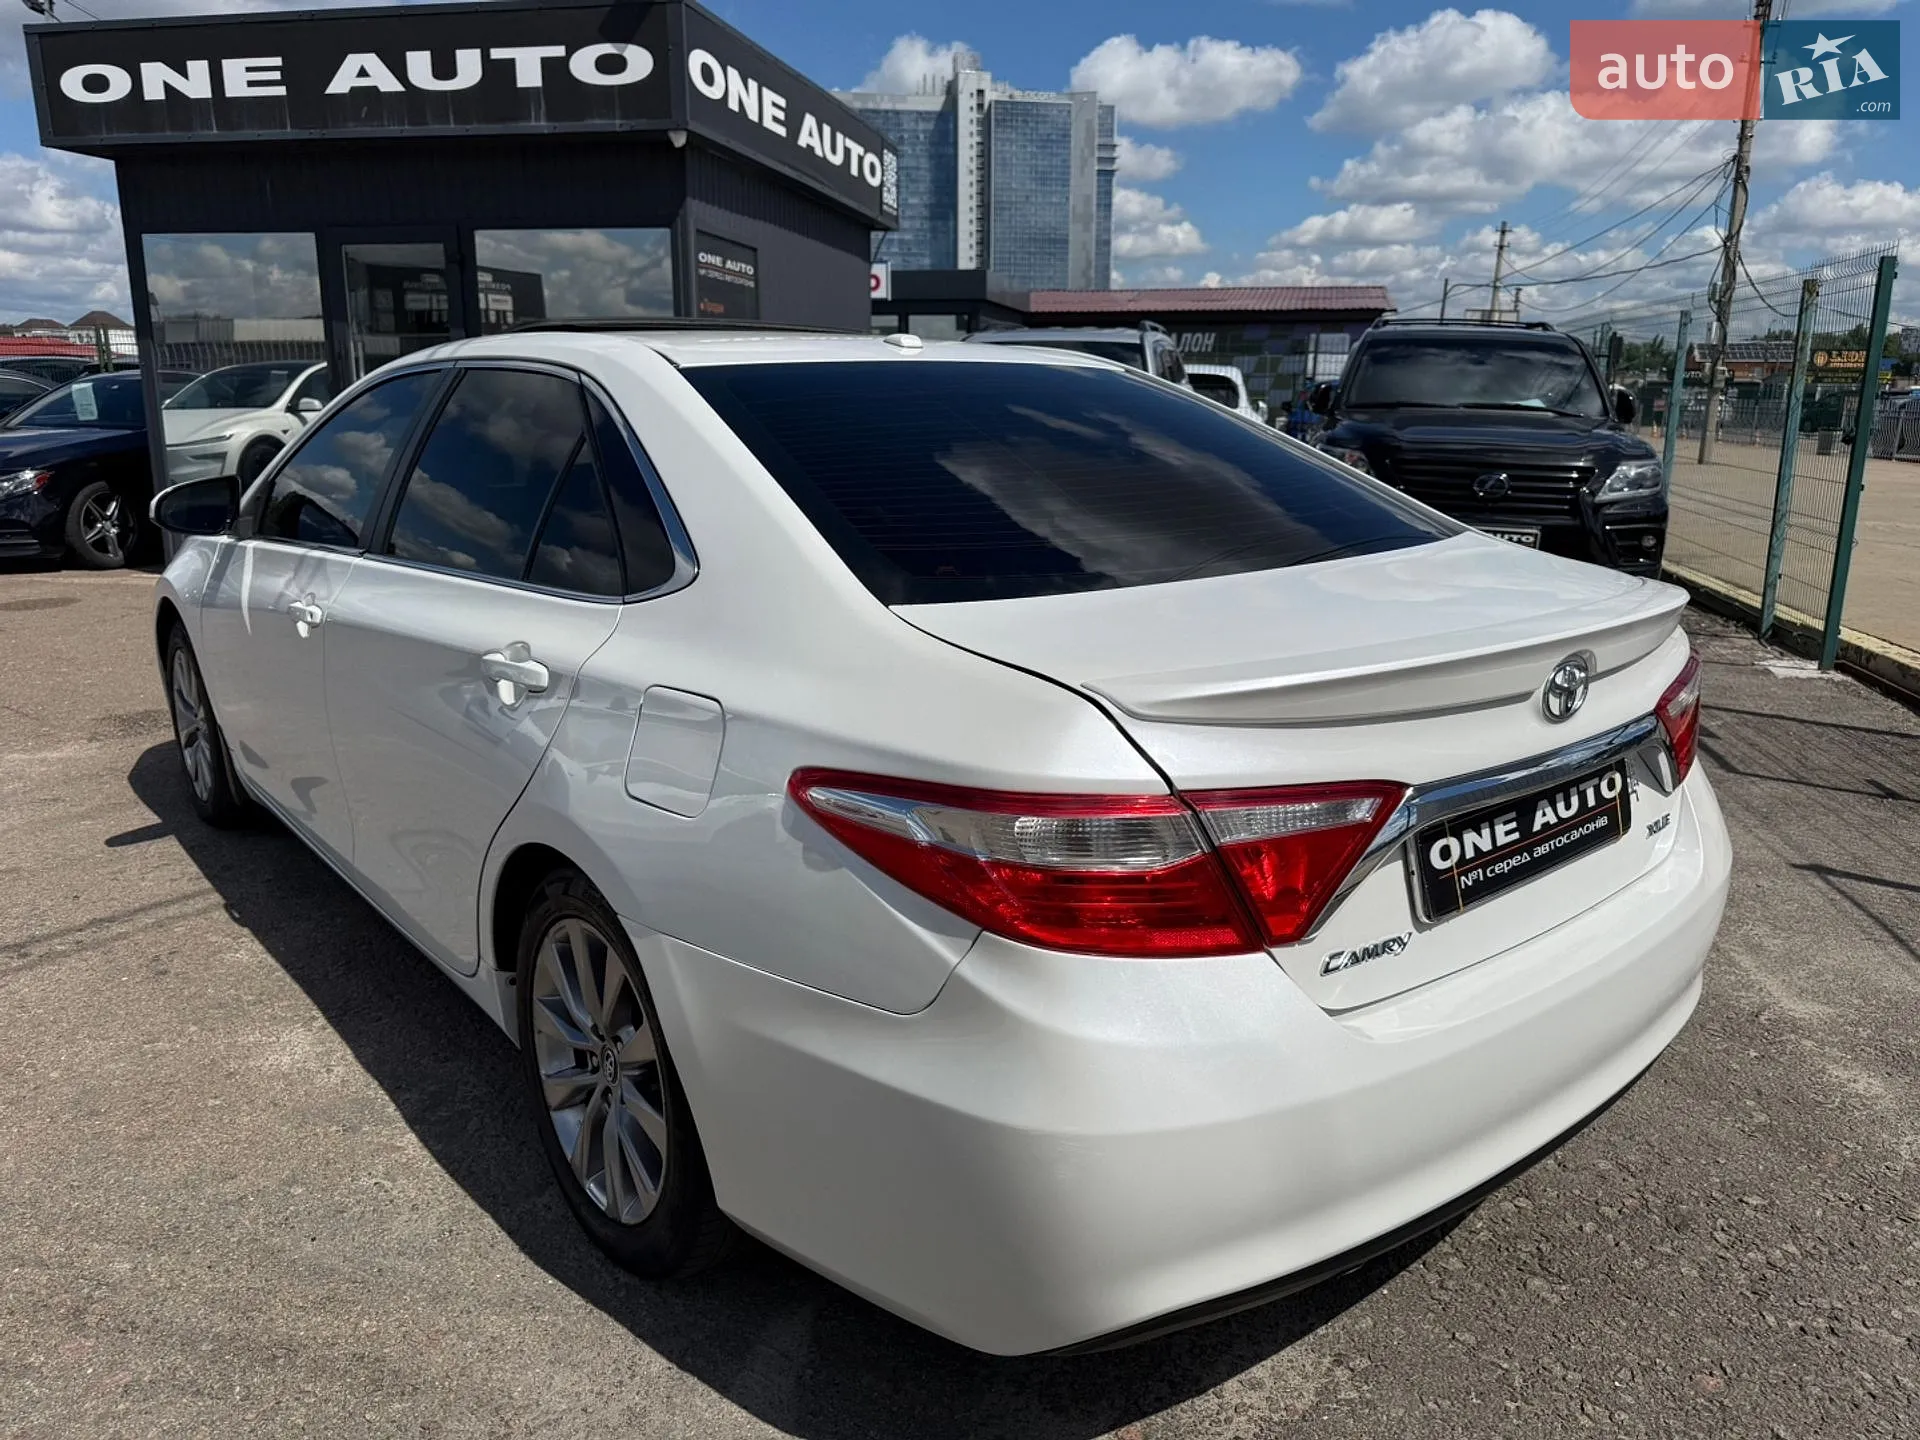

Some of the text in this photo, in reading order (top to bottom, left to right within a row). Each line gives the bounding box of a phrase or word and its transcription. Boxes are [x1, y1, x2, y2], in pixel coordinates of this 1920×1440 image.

[59, 42, 655, 103] ONE AUTO
[688, 48, 882, 187] ONE AUTO
[698, 252, 754, 275] ONE AUTO
[1429, 770, 1623, 871] ONE AUTO
[1460, 815, 1608, 889] №1 серед автосалонів
[1319, 931, 1413, 977] CAMRY
